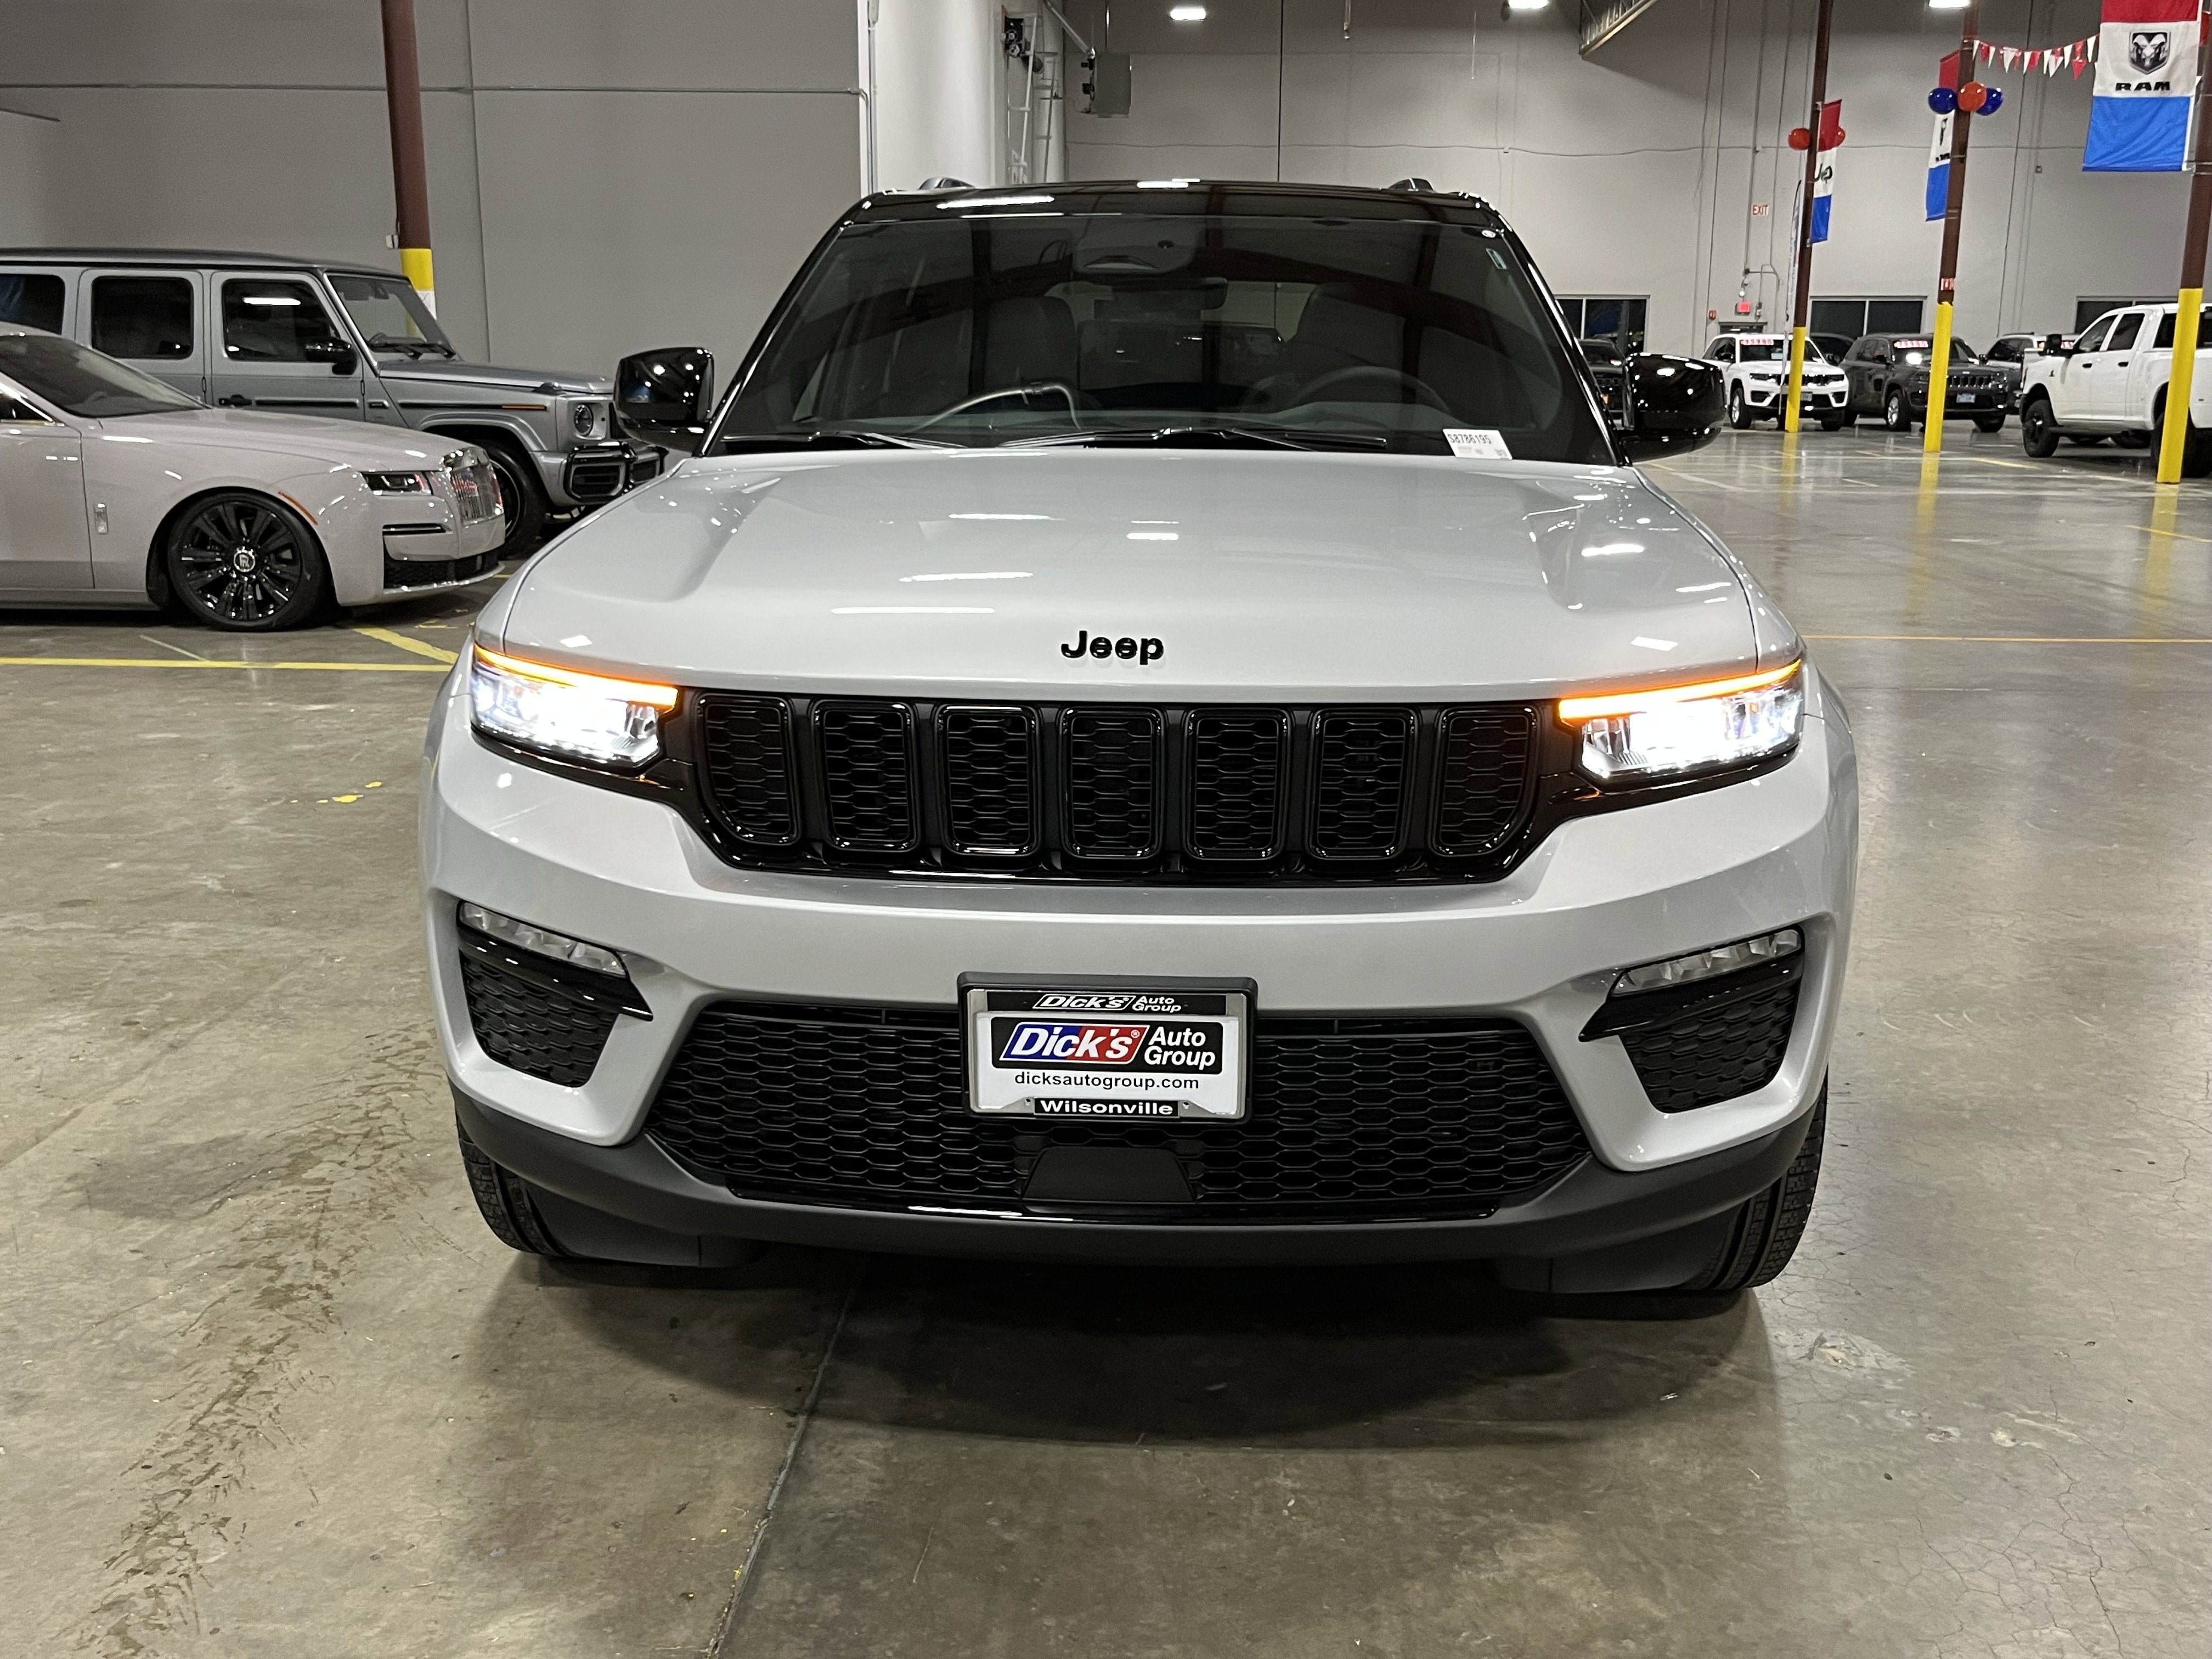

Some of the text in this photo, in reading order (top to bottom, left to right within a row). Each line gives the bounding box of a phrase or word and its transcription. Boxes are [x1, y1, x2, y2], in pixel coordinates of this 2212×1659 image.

[2115, 82, 2170, 91] RAM
[1752, 204, 1769, 216] EXIT
[1060, 630, 1164, 665] Jeep
[1040, 996, 1125, 1008] Dick's
[1132, 1003, 1182, 1013] Group
[1136, 996, 1175, 1005] Auto
[1011, 1026, 1131, 1059] Dick's
[1148, 1026, 1206, 1047] Auto
[1144, 1046, 1216, 1070] Group
[1014, 1071, 1199, 1091] dicksautogroup.com
[1040, 1100, 1174, 1115] Wilsonville
